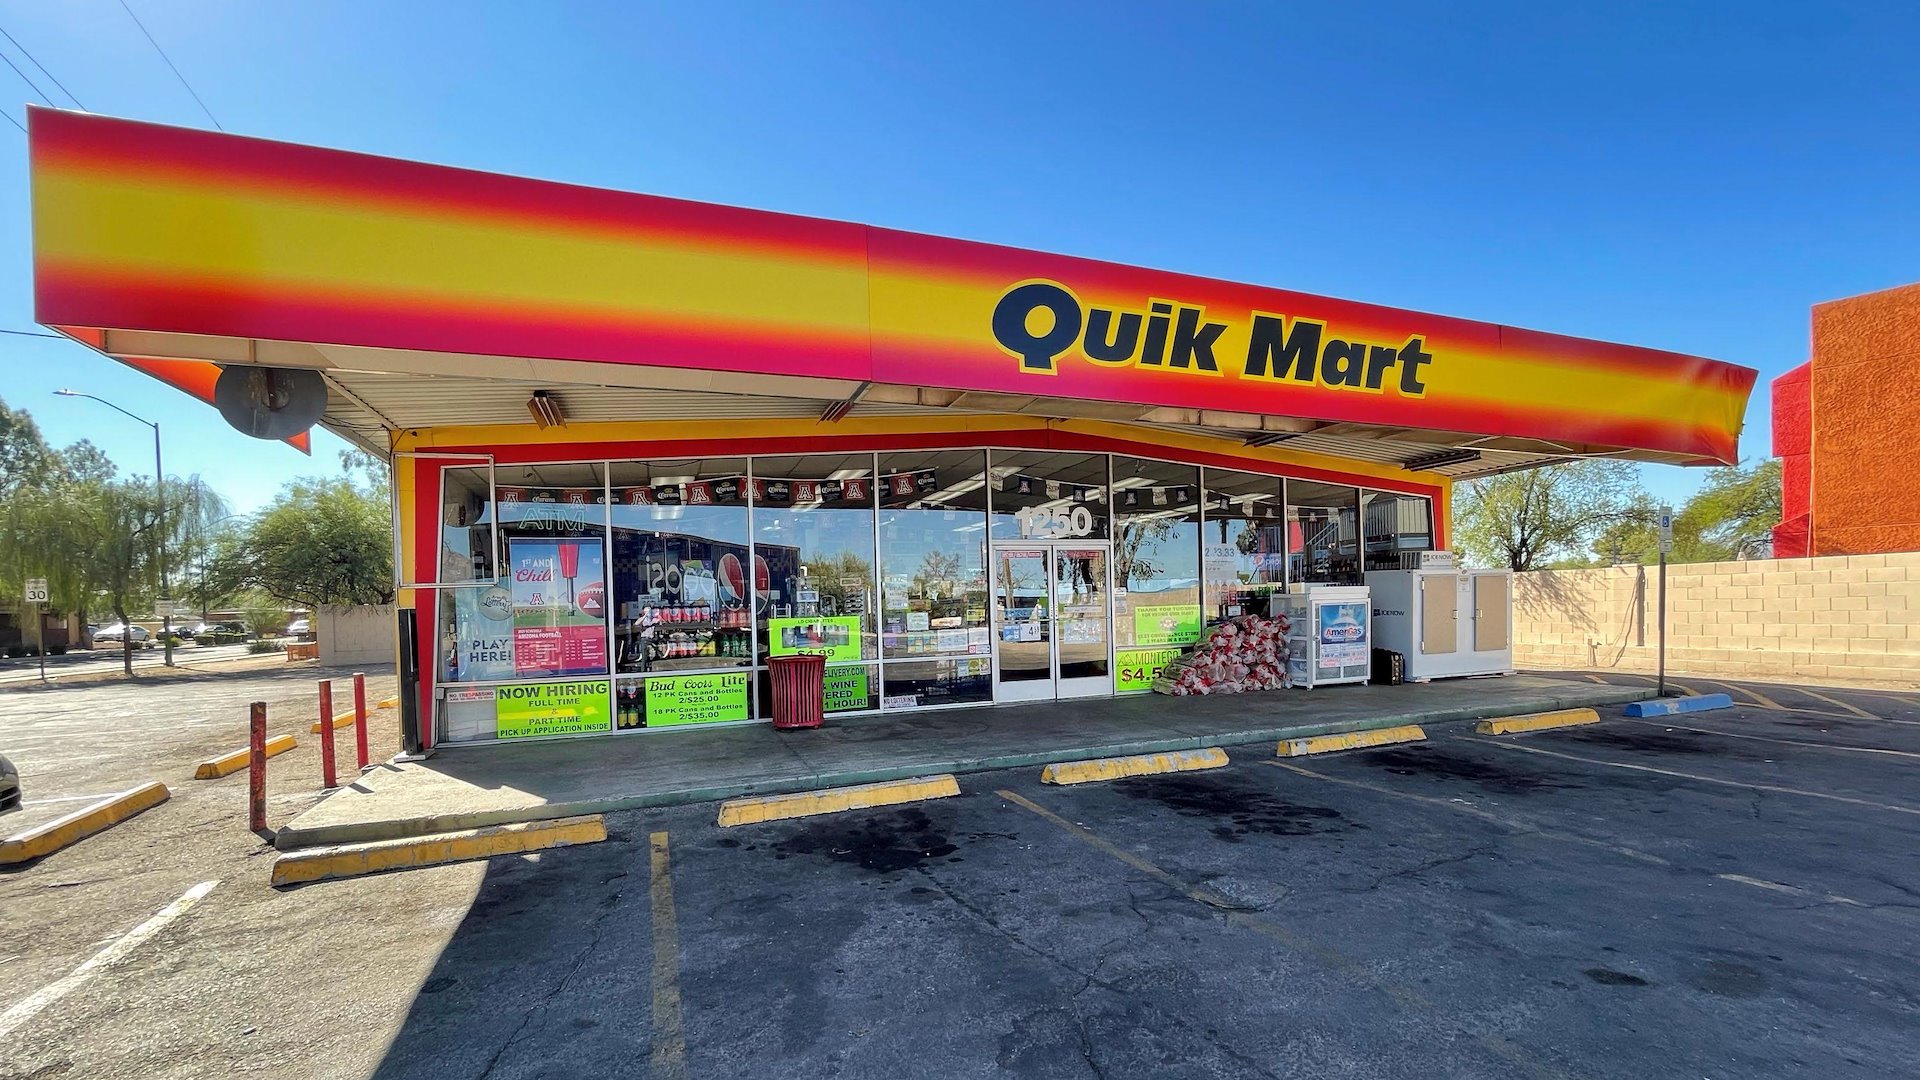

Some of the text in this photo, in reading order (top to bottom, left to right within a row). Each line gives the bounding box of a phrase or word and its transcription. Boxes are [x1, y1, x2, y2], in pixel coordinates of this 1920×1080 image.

[990, 282, 1433, 395] Quik Mart
[715, 485, 737, 494] Corona
[657, 491, 680, 500] Corona
[518, 507, 587, 532] ATM
[1014, 506, 1093, 537] 1250
[533, 558, 551, 568] AND
[28, 590, 46, 600] 30
[472, 639, 509, 650] PLAY
[470, 650, 512, 662] HERE!
[824, 667, 865, 678] ELIVERY.COM
[1121, 666, 1166, 685] $4.5
[649, 680, 675, 692] Bud
[721, 675, 745, 688] Lite
[830, 681, 858, 689] WINE
[500, 683, 608, 700] NOW HIRING
[823, 690, 853, 699] ERED
[528, 698, 581, 707] FULL TIME
[679, 695, 719, 704] 2/$25.00
[833, 699, 866, 708] HOUR!
[558, 715, 581, 723] TIME
[679, 711, 719, 720] 2/$35.00
[500, 729, 518, 737] PICK
[533, 725, 582, 735] APPLICATION
[584, 722, 608, 730] INSIDE
